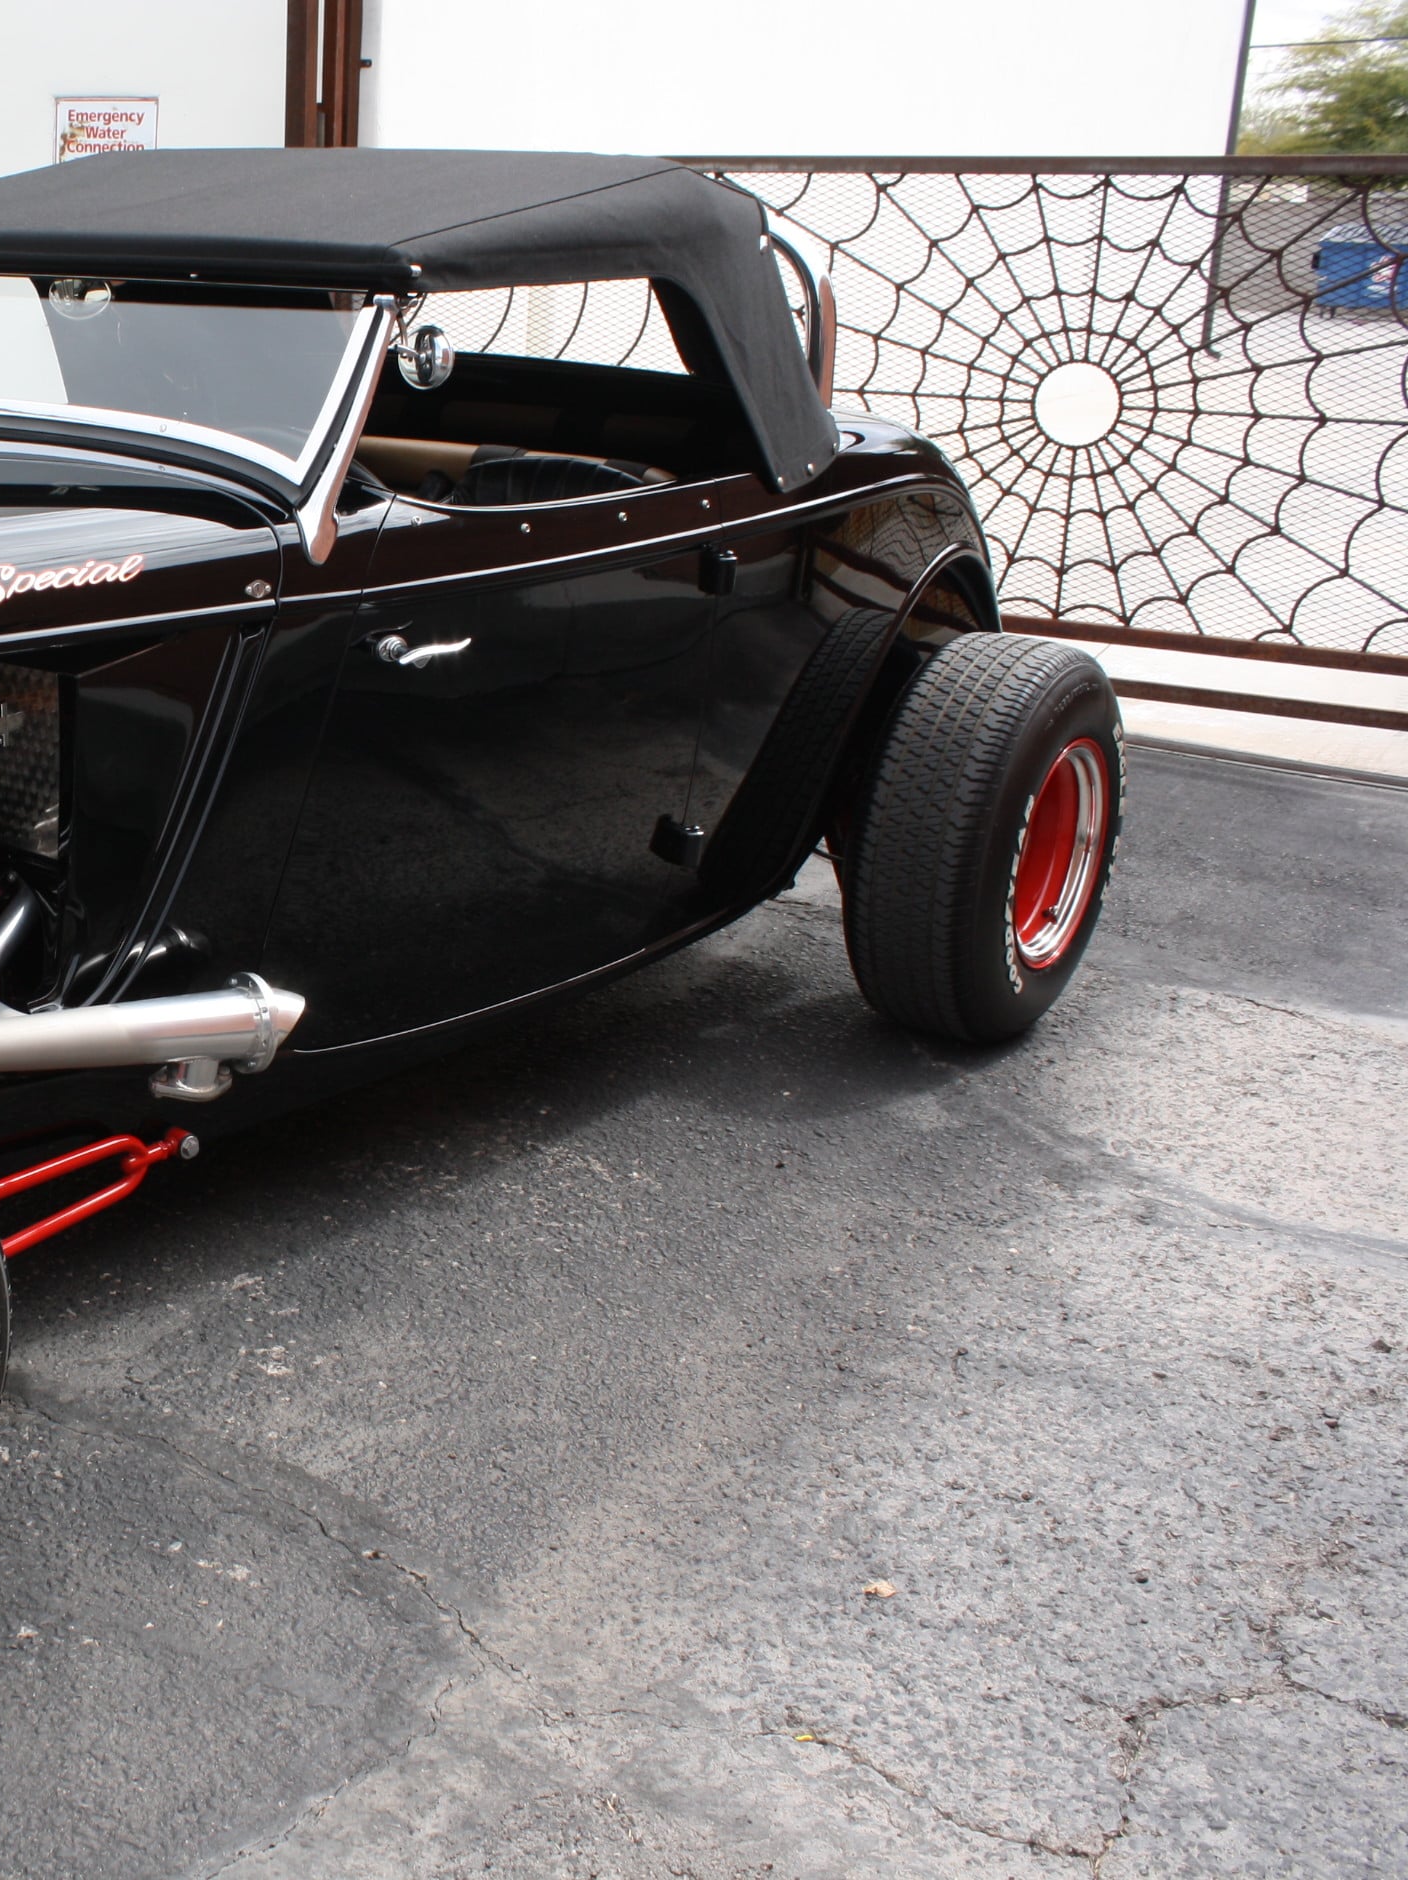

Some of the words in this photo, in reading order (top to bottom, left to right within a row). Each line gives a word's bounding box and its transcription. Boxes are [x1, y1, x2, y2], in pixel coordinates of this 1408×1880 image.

[67, 109, 145, 125] Emergency
[85, 126, 127, 139] Water
[66, 140, 145, 153] Connection
